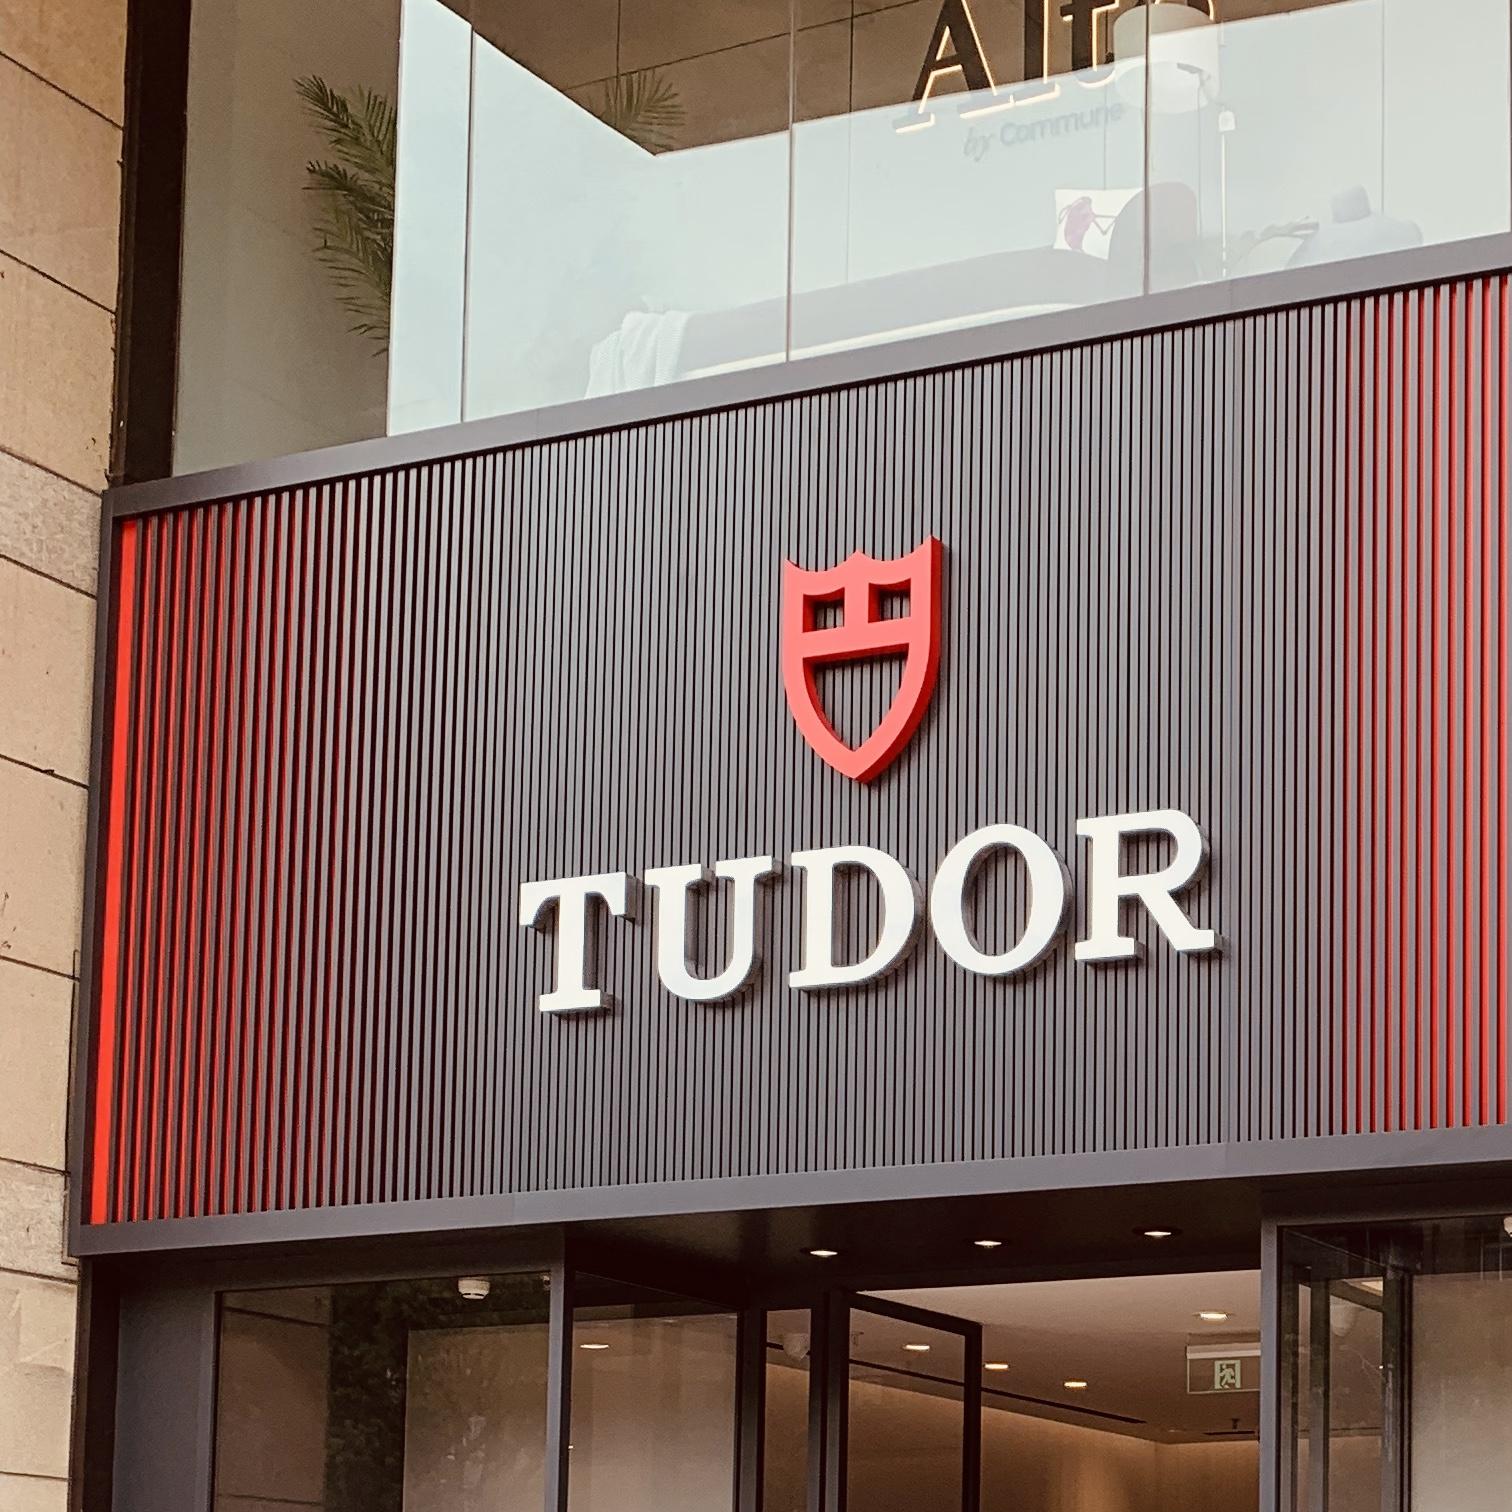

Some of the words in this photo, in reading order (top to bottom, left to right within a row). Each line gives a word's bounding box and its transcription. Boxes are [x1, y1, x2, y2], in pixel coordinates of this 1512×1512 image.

[893, 0, 1215, 133] Alt
[1000, 102, 1125, 147] Commune
[519, 808, 1222, 1015] TUDOR
